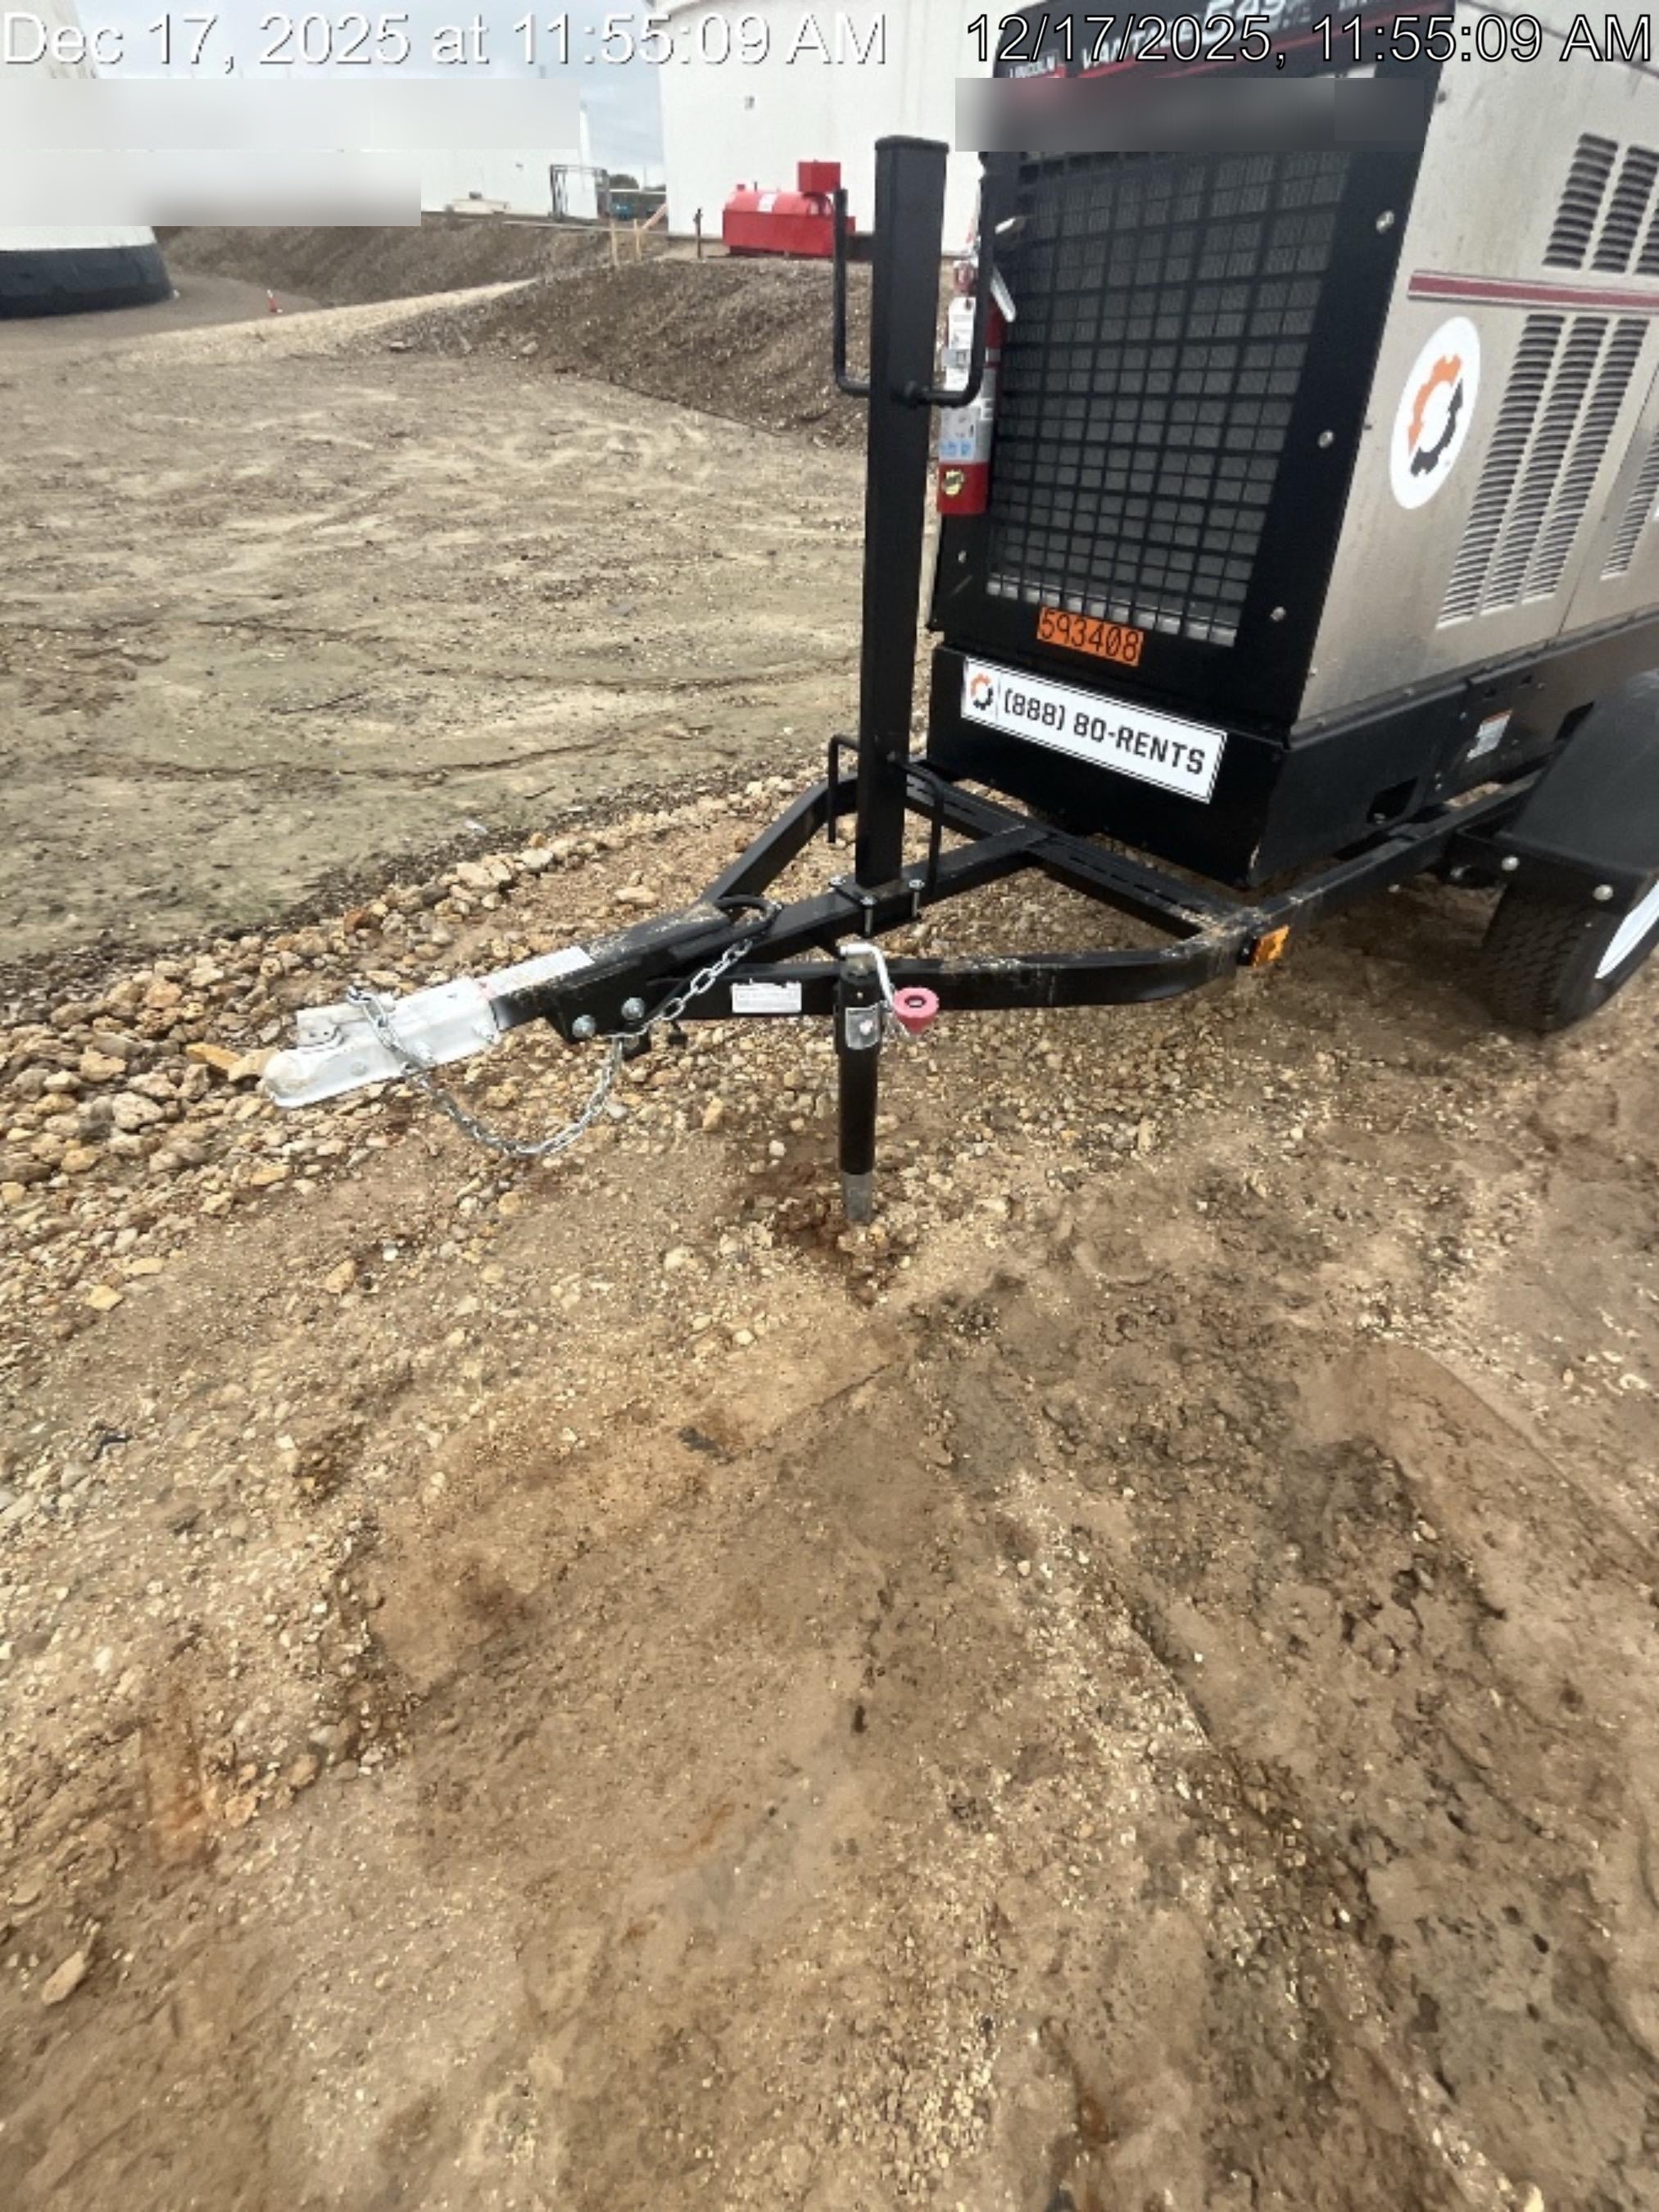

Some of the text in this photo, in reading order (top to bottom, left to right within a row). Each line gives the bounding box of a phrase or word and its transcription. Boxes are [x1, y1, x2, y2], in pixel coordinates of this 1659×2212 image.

[1040, 608, 1141, 663] 593408
[1003, 687, 1207, 775] (888) 80-RENTS
